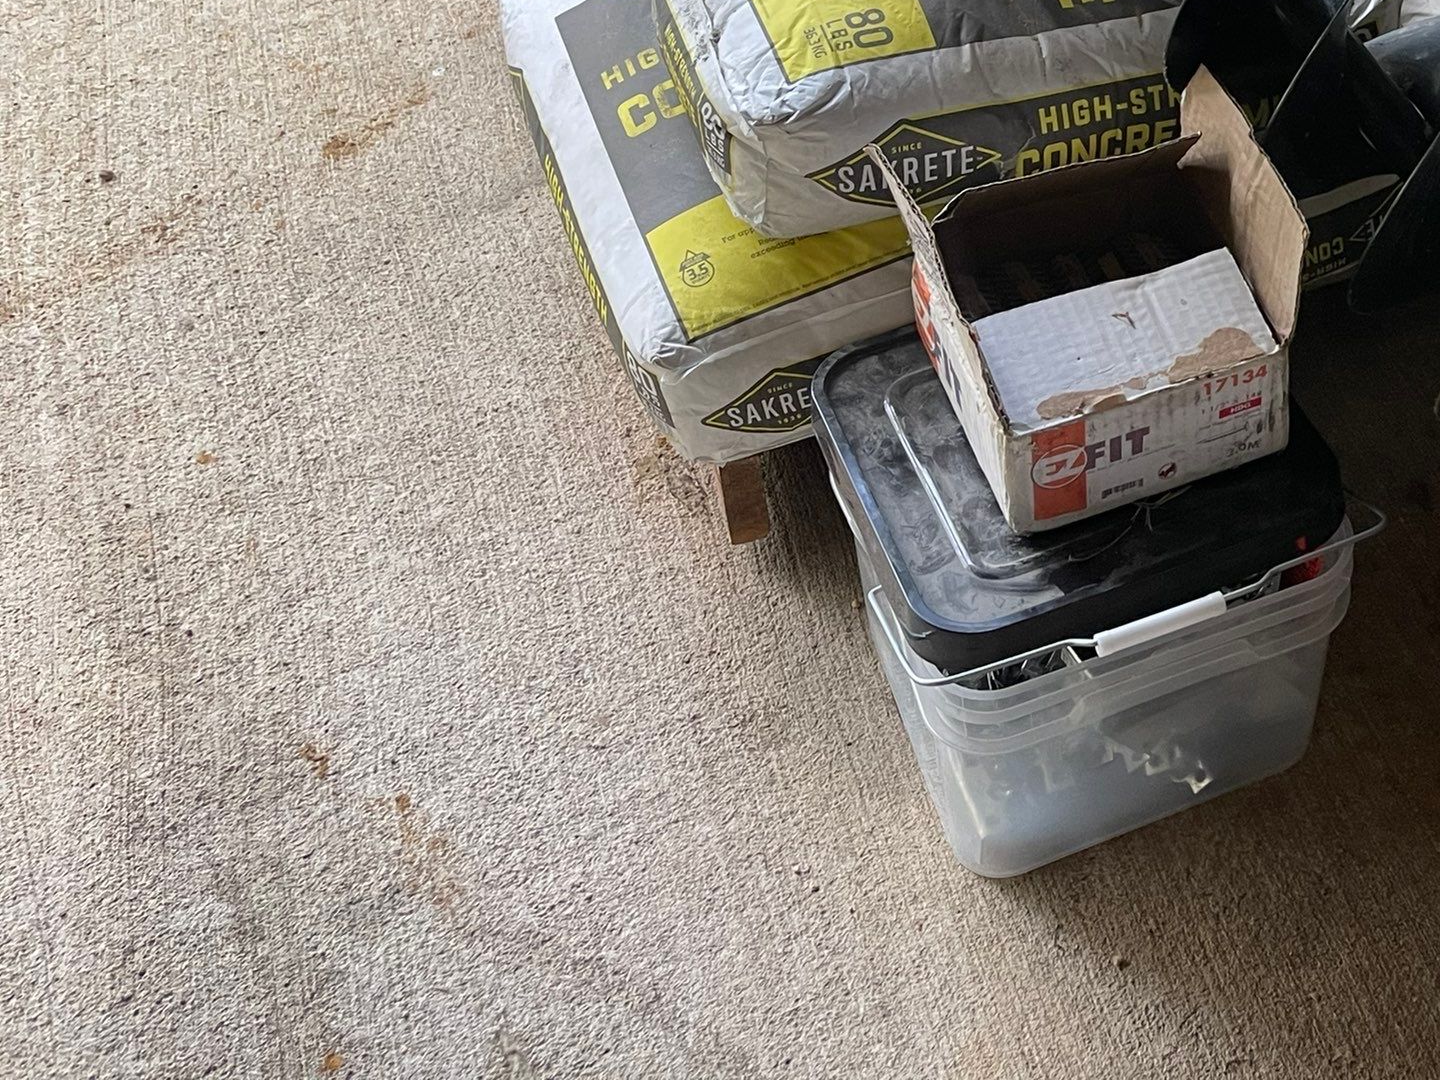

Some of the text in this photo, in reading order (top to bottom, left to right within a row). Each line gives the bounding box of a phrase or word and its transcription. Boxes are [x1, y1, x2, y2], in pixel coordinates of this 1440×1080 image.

[826, 18, 853, 52] LBS
[845, 8, 894, 49] 80
[812, 44, 828, 59] KG
[1038, 83, 1181, 135] HIGH-STR
[891, 141, 923, 154] SINCE
[1015, 120, 1177, 178] CONCRE
[687, 262, 710, 281] 3.5
[767, 382, 794, 394] SINCE
[1203, 364, 1268, 396] 17134
[726, 387, 812, 428] SAKRE
[1085, 426, 1150, 470] FIT
